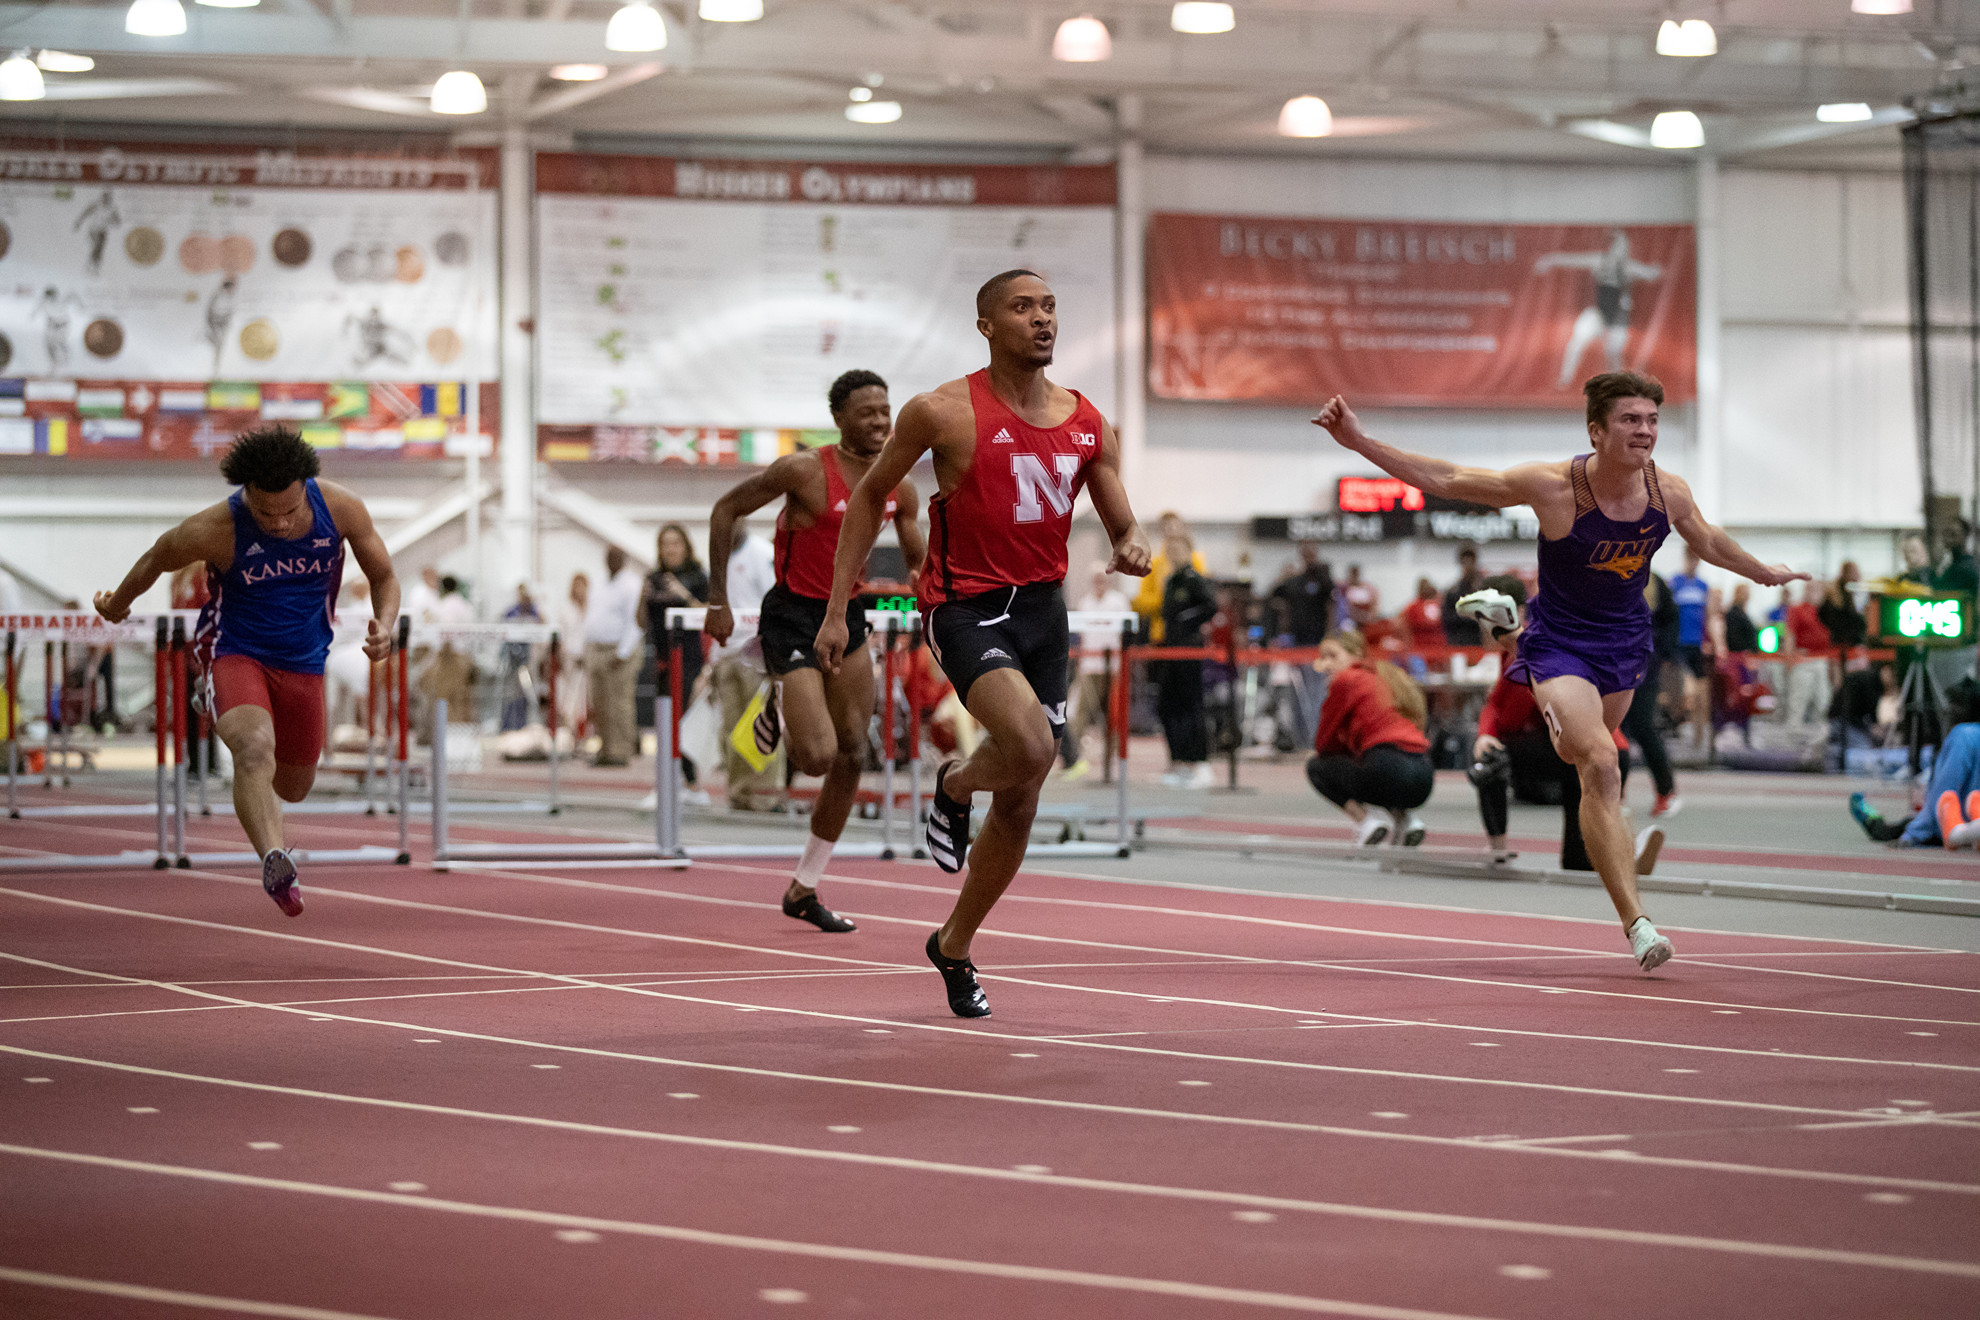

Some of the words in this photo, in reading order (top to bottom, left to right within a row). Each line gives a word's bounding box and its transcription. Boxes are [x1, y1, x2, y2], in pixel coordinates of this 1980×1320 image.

[1220, 223, 1336, 258] BECKY
[1010, 453, 1080, 524] N
[1589, 537, 1656, 566] UNI
[241, 557, 335, 586] KANSAS
